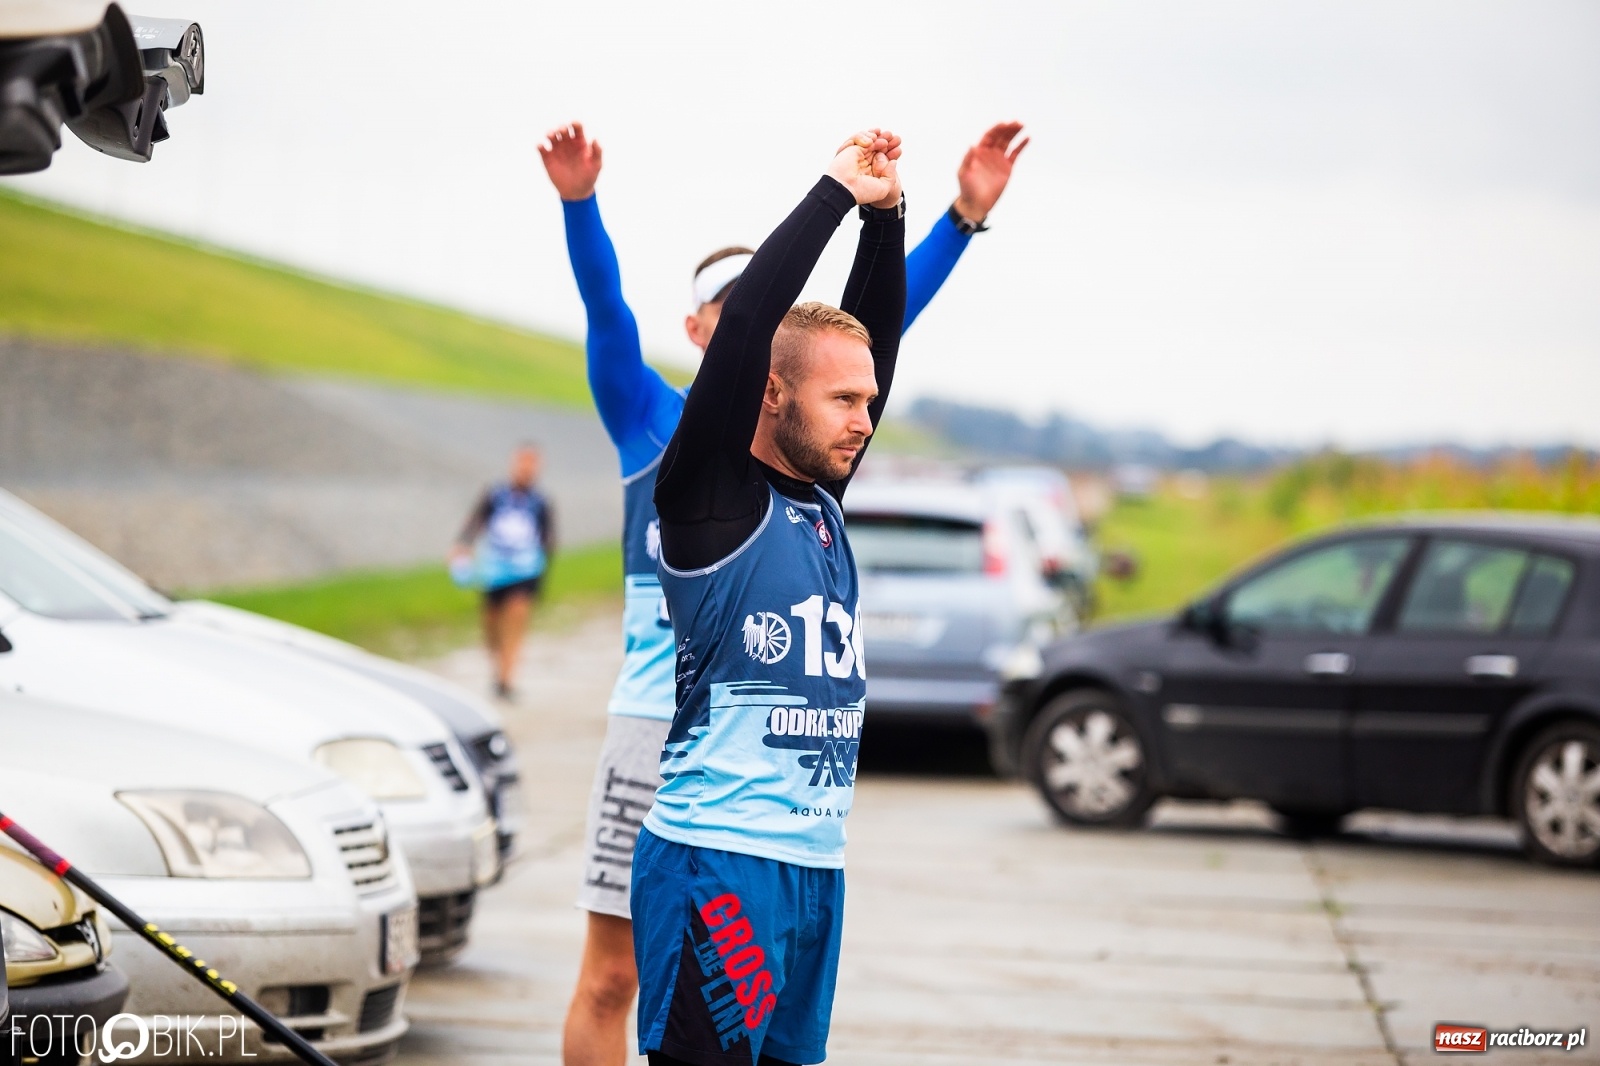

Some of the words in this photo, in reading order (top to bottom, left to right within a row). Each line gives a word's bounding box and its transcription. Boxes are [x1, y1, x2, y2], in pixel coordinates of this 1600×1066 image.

[770, 707, 828, 737] ODRA
[586, 767, 658, 892] FIGHT
[790, 806, 832, 818] AQUA
[700, 893, 777, 1030] CROSS
[700, 973, 749, 1052] LINE
